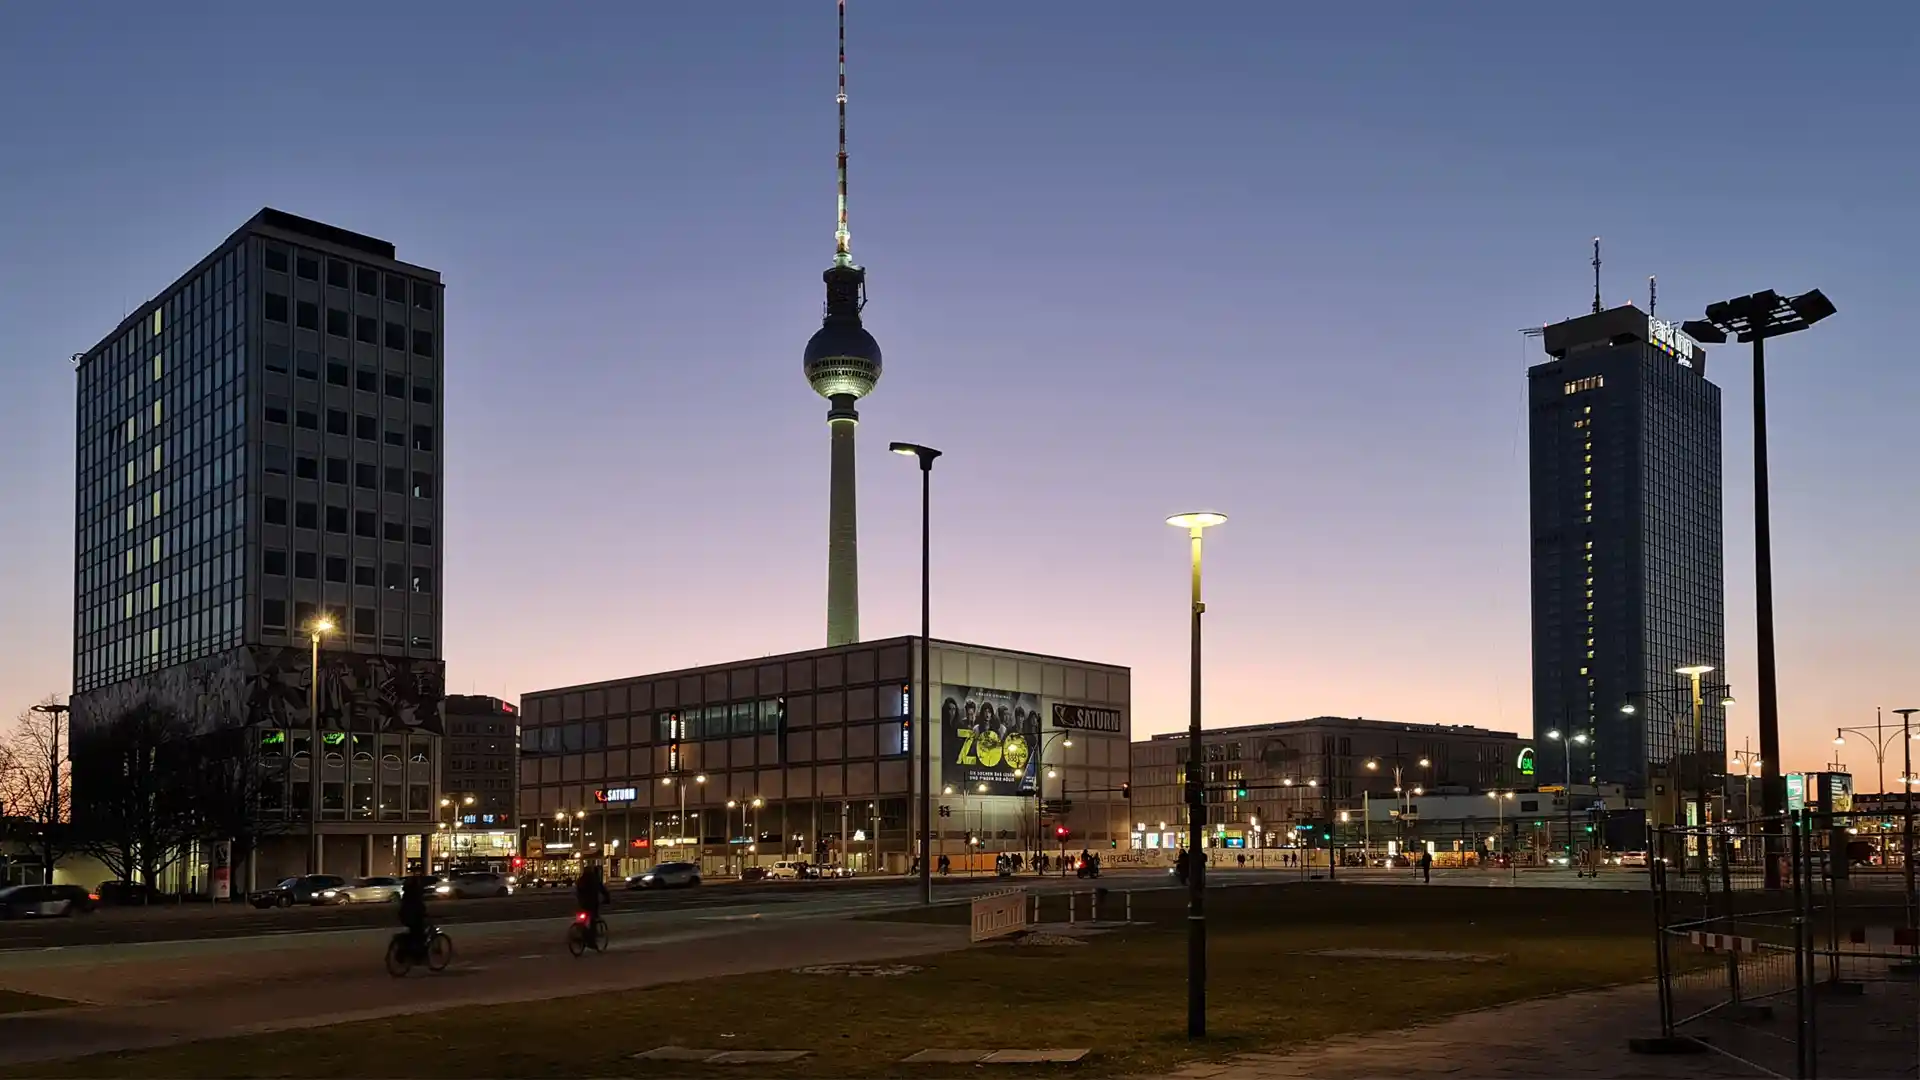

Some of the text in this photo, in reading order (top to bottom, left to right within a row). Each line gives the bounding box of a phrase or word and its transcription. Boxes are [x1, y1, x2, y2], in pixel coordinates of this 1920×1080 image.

[1077, 708, 1119, 731] SATURN
[956, 728, 1029, 769] ZOO
[607, 788, 636, 801] SATURN
